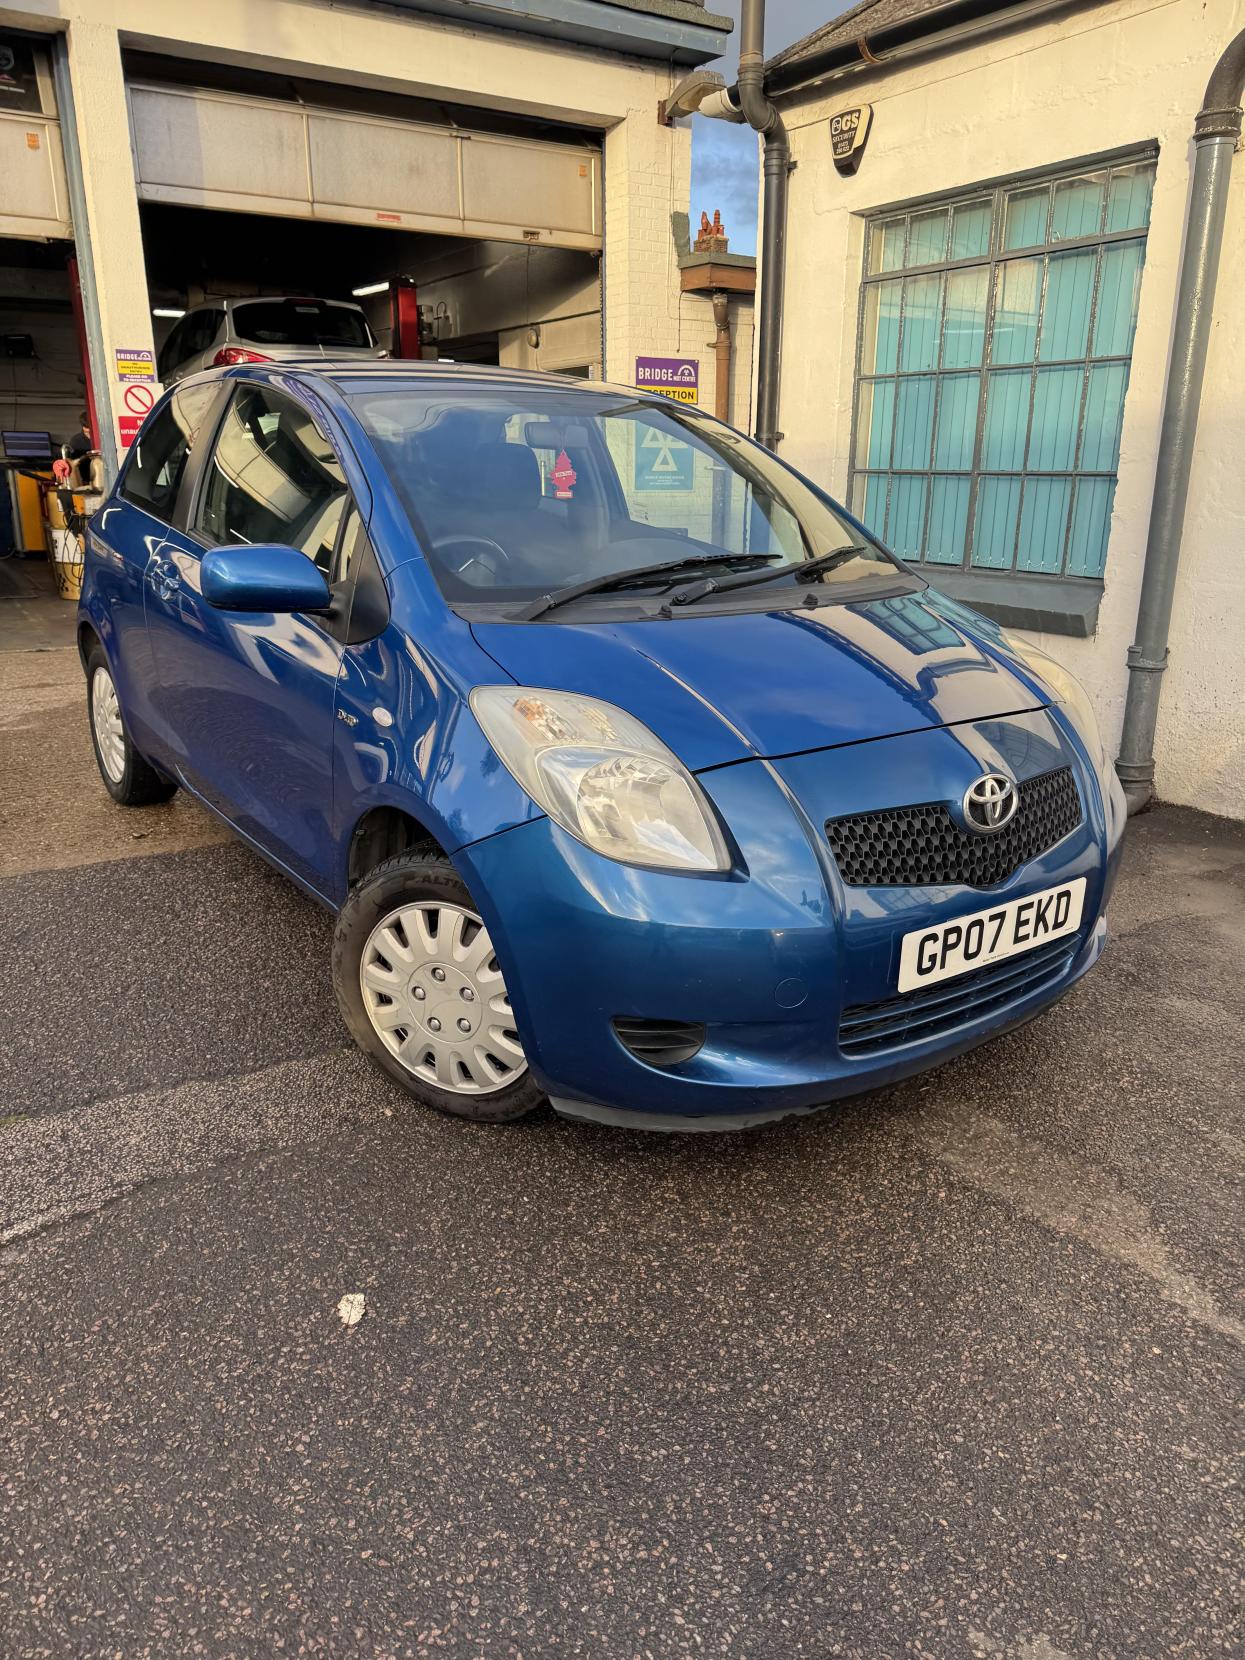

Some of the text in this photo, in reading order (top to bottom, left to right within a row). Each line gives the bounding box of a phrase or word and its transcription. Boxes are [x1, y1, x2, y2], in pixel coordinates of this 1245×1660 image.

[832, 131, 856, 143] SECURITY
[638, 367, 673, 381] BRIDGE
[916, 889, 1072, 976] GP07 EKD
